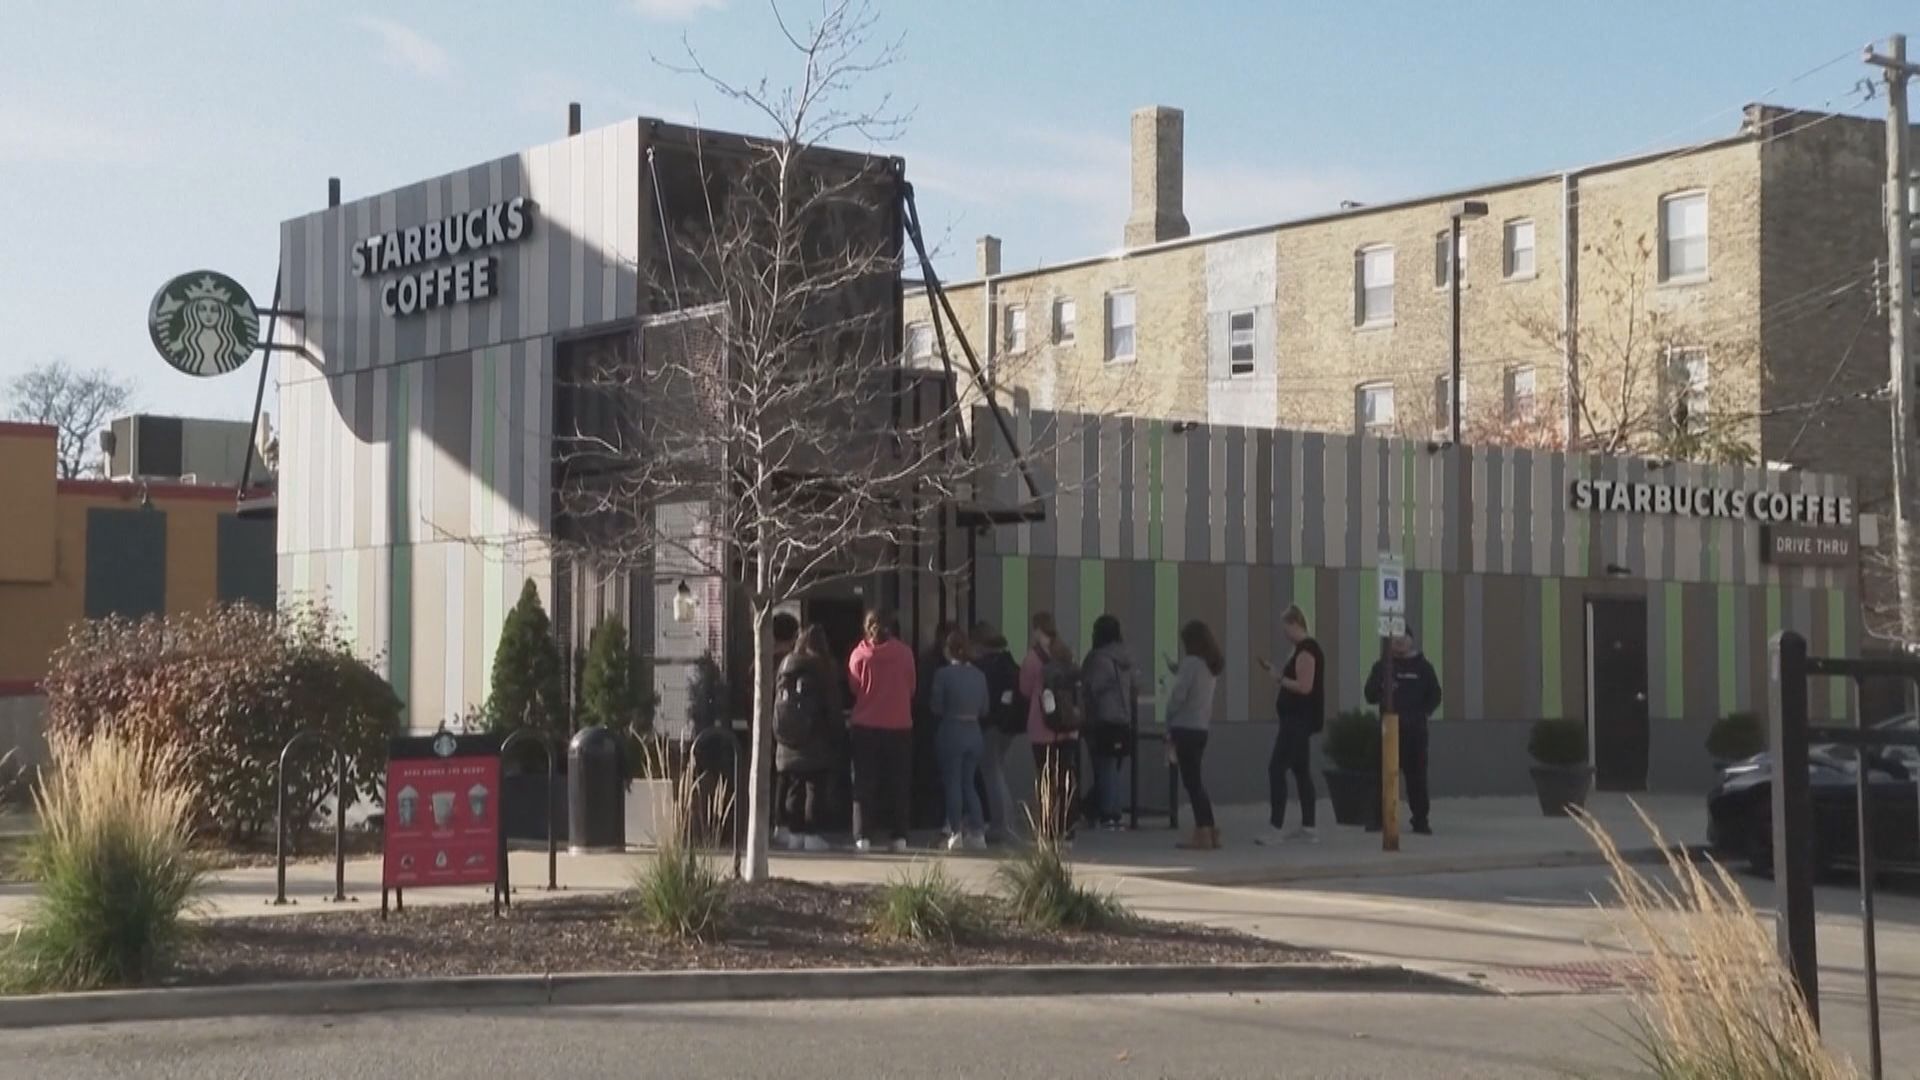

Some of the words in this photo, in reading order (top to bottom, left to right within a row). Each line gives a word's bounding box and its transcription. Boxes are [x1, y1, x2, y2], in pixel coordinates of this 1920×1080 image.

[352, 196, 525, 277] STARBUCKS
[381, 257, 490, 316] COFFEE
[1575, 480, 1745, 519] STARBUCKS
[1753, 491, 1852, 525] COFFEE
[1776, 536, 1811, 554] DRIVE
[1817, 538, 1849, 555] THRU
